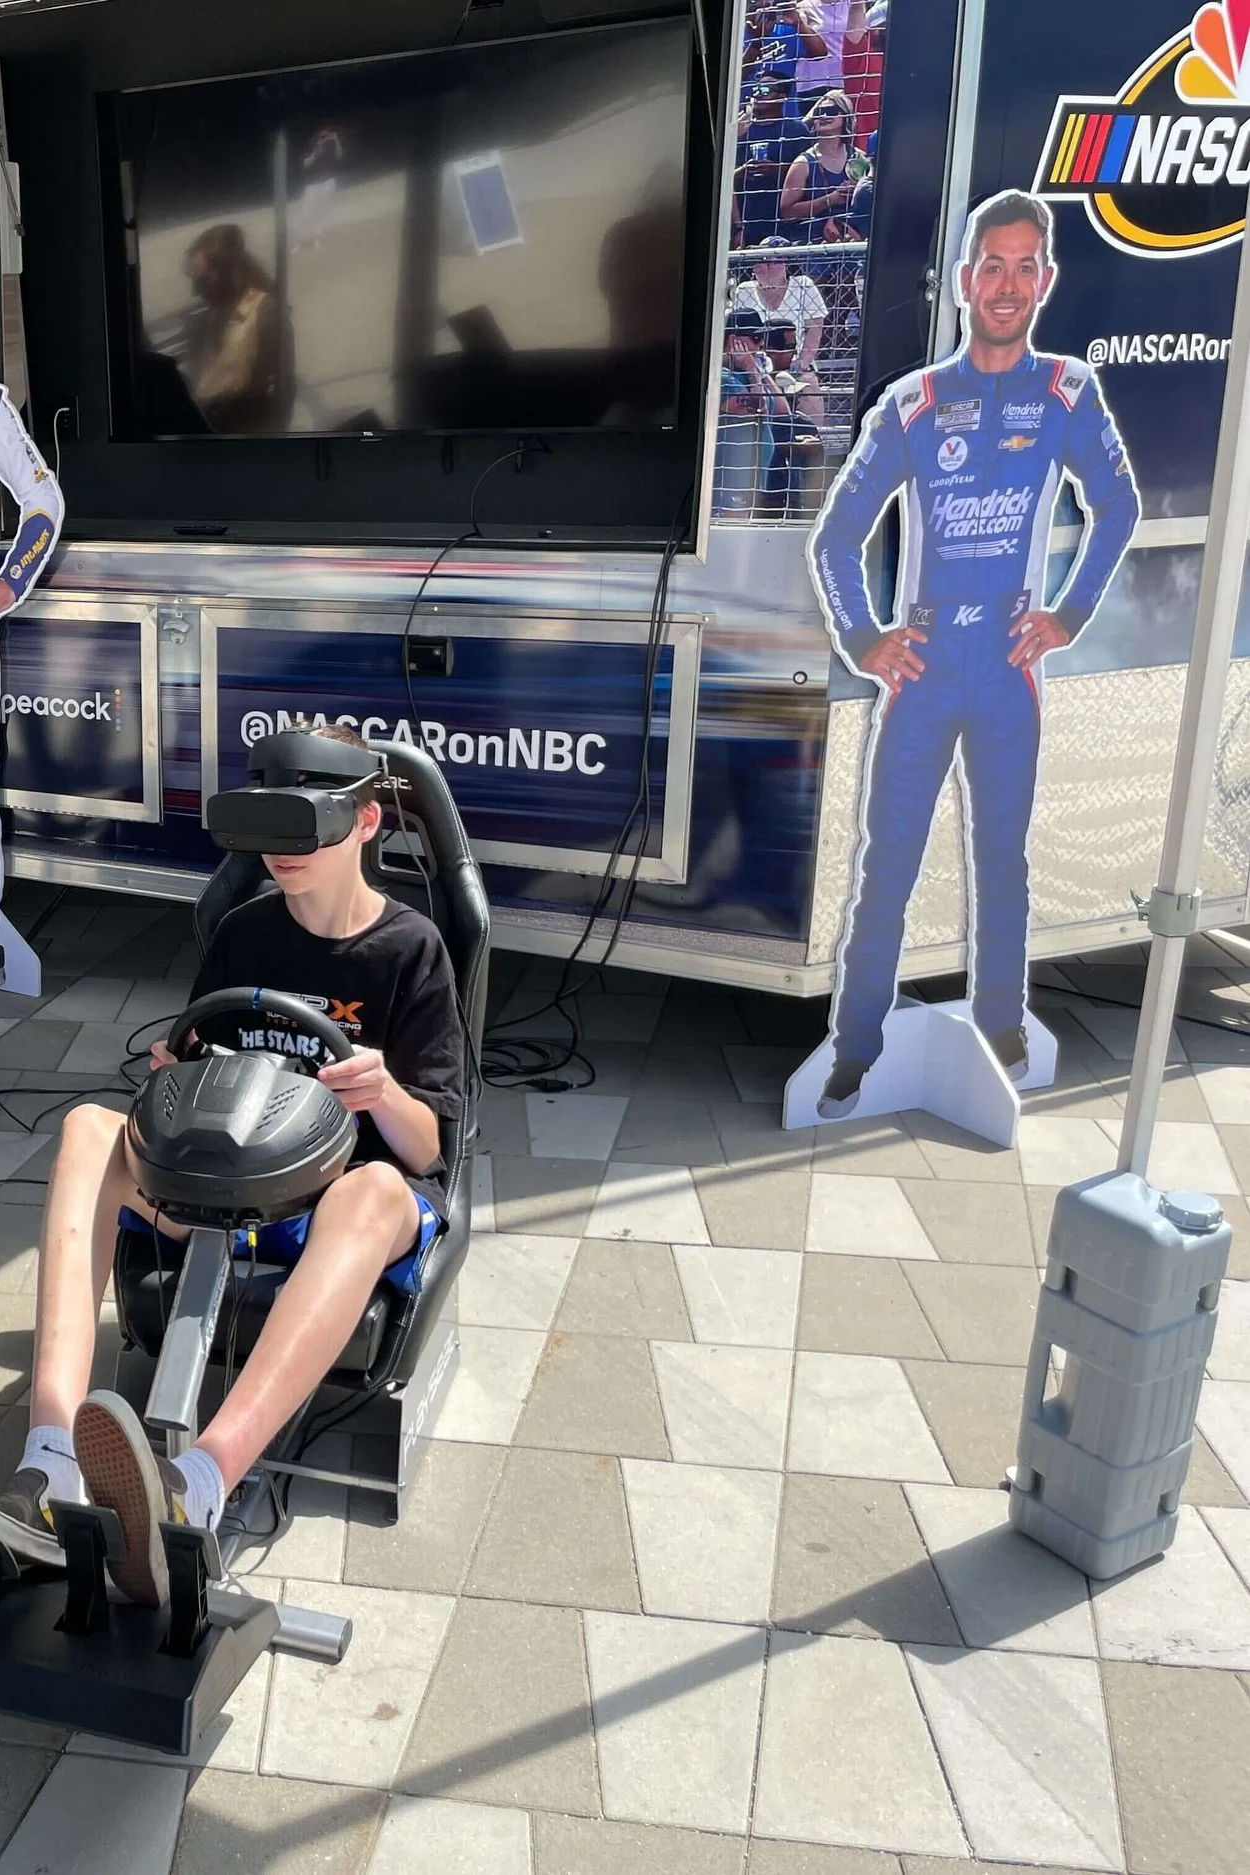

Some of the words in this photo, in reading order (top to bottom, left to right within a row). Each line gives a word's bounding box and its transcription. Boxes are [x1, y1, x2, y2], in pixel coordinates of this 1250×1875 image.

[1002, 403, 1046, 416] Hendrick
[928, 475, 975, 488] GOODYEAR
[928, 486, 1034, 533] Hendrick
[944, 515, 1025, 538] cars.com
[1, 692, 112, 724] peacock
[239, 1027, 266, 1049] HE
[266, 1029, 320, 1058] STARS
